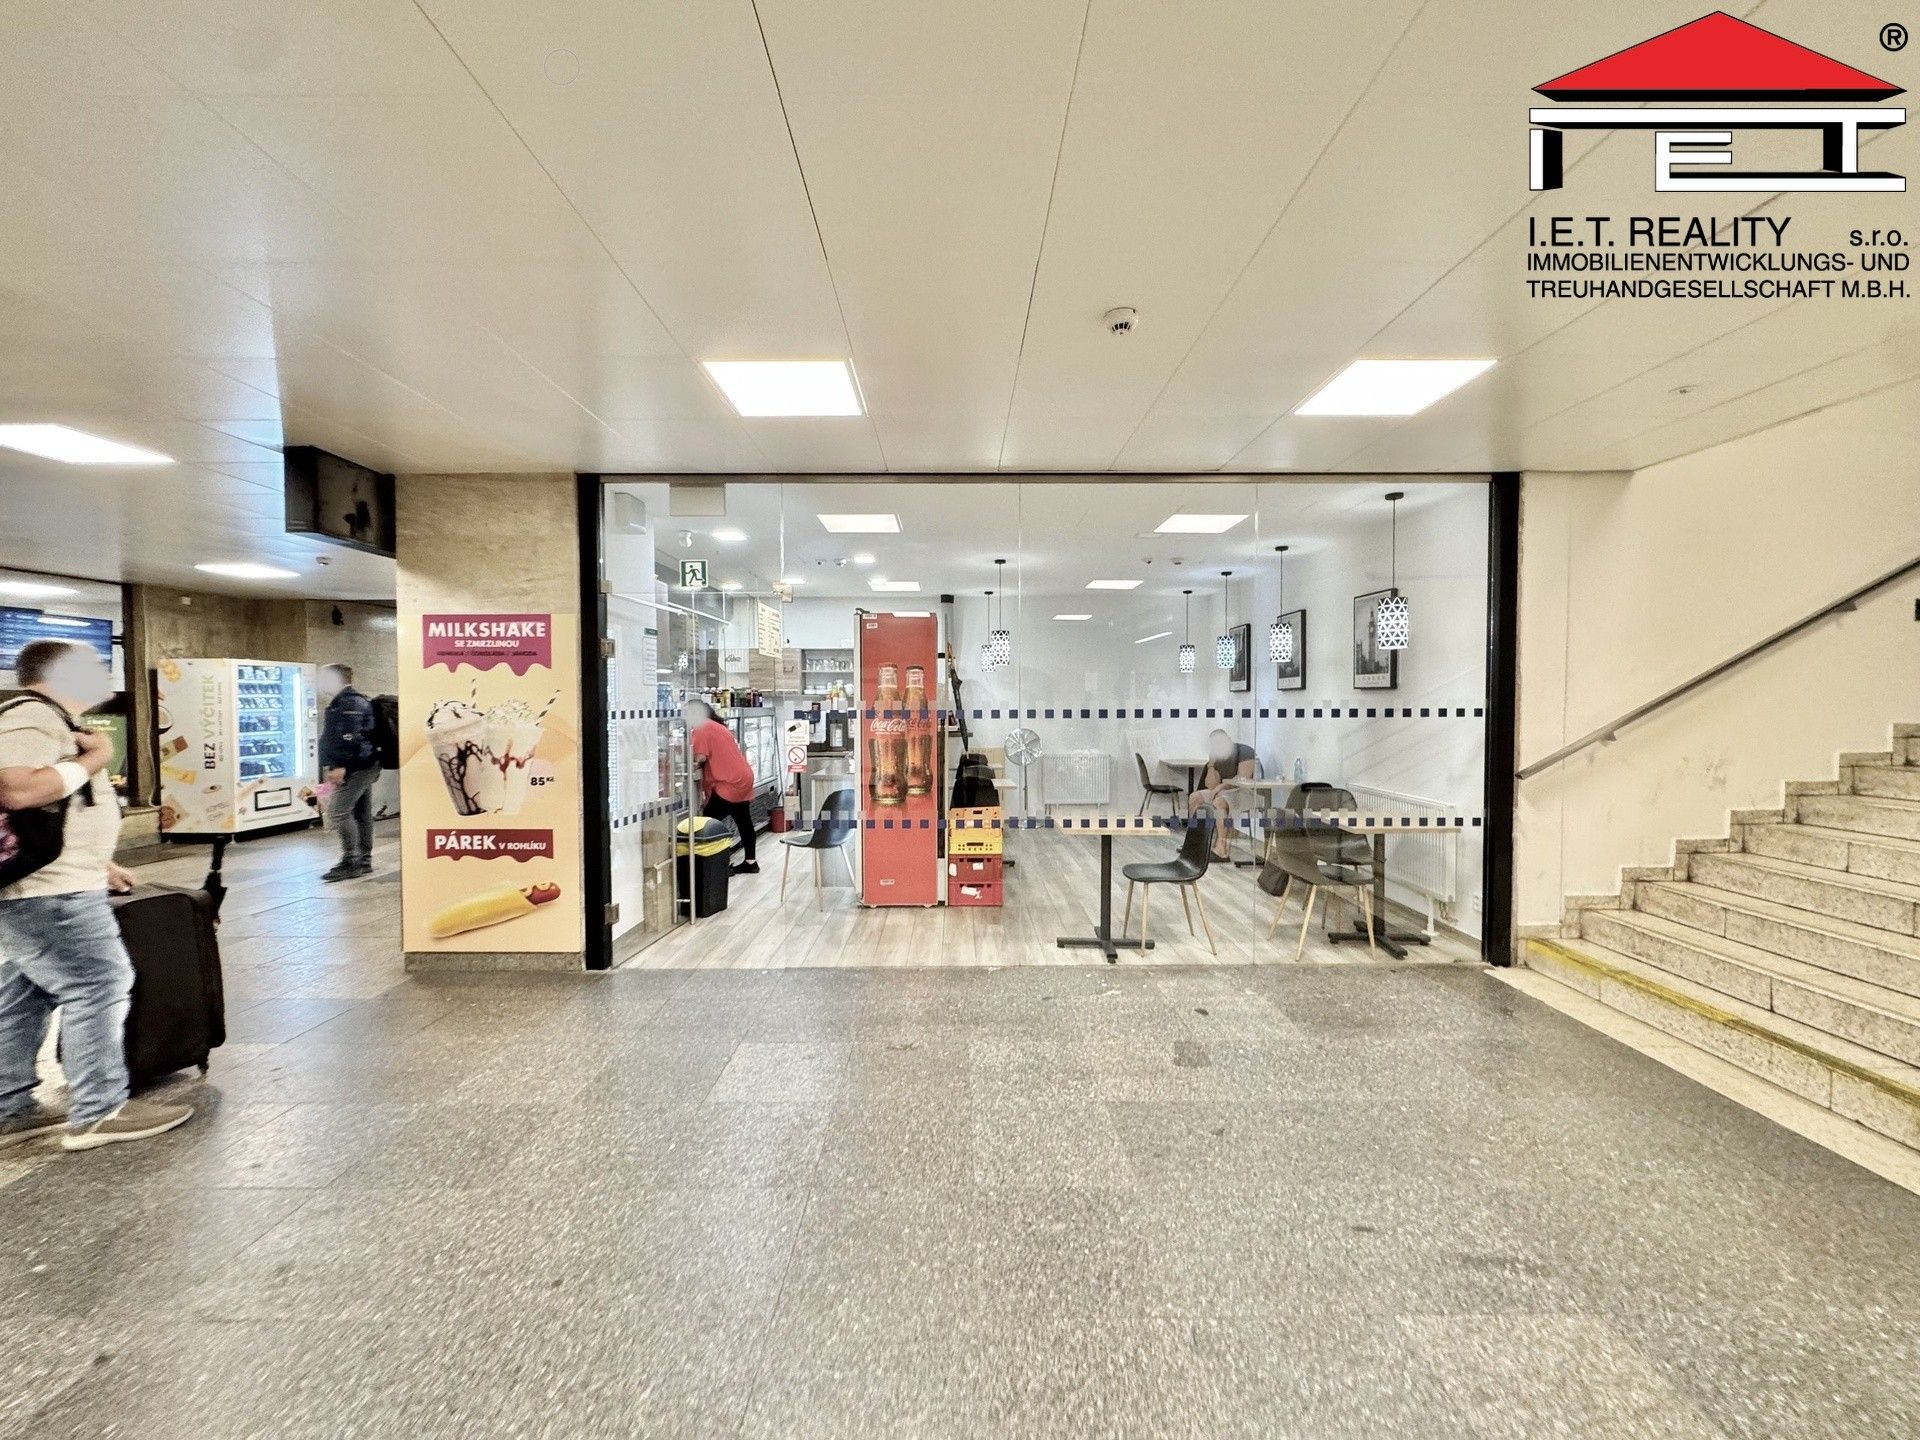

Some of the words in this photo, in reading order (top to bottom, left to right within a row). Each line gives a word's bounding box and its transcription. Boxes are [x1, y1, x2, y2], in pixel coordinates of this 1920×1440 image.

[428, 622, 546, 637] MILKSHAKE
[454, 640, 465, 648] SE
[204, 743, 216, 769] BEZ
[530, 777, 545, 786] 85
[434, 831, 497, 850] PÁREK
[507, 841, 547, 850] ROHLÍKU
